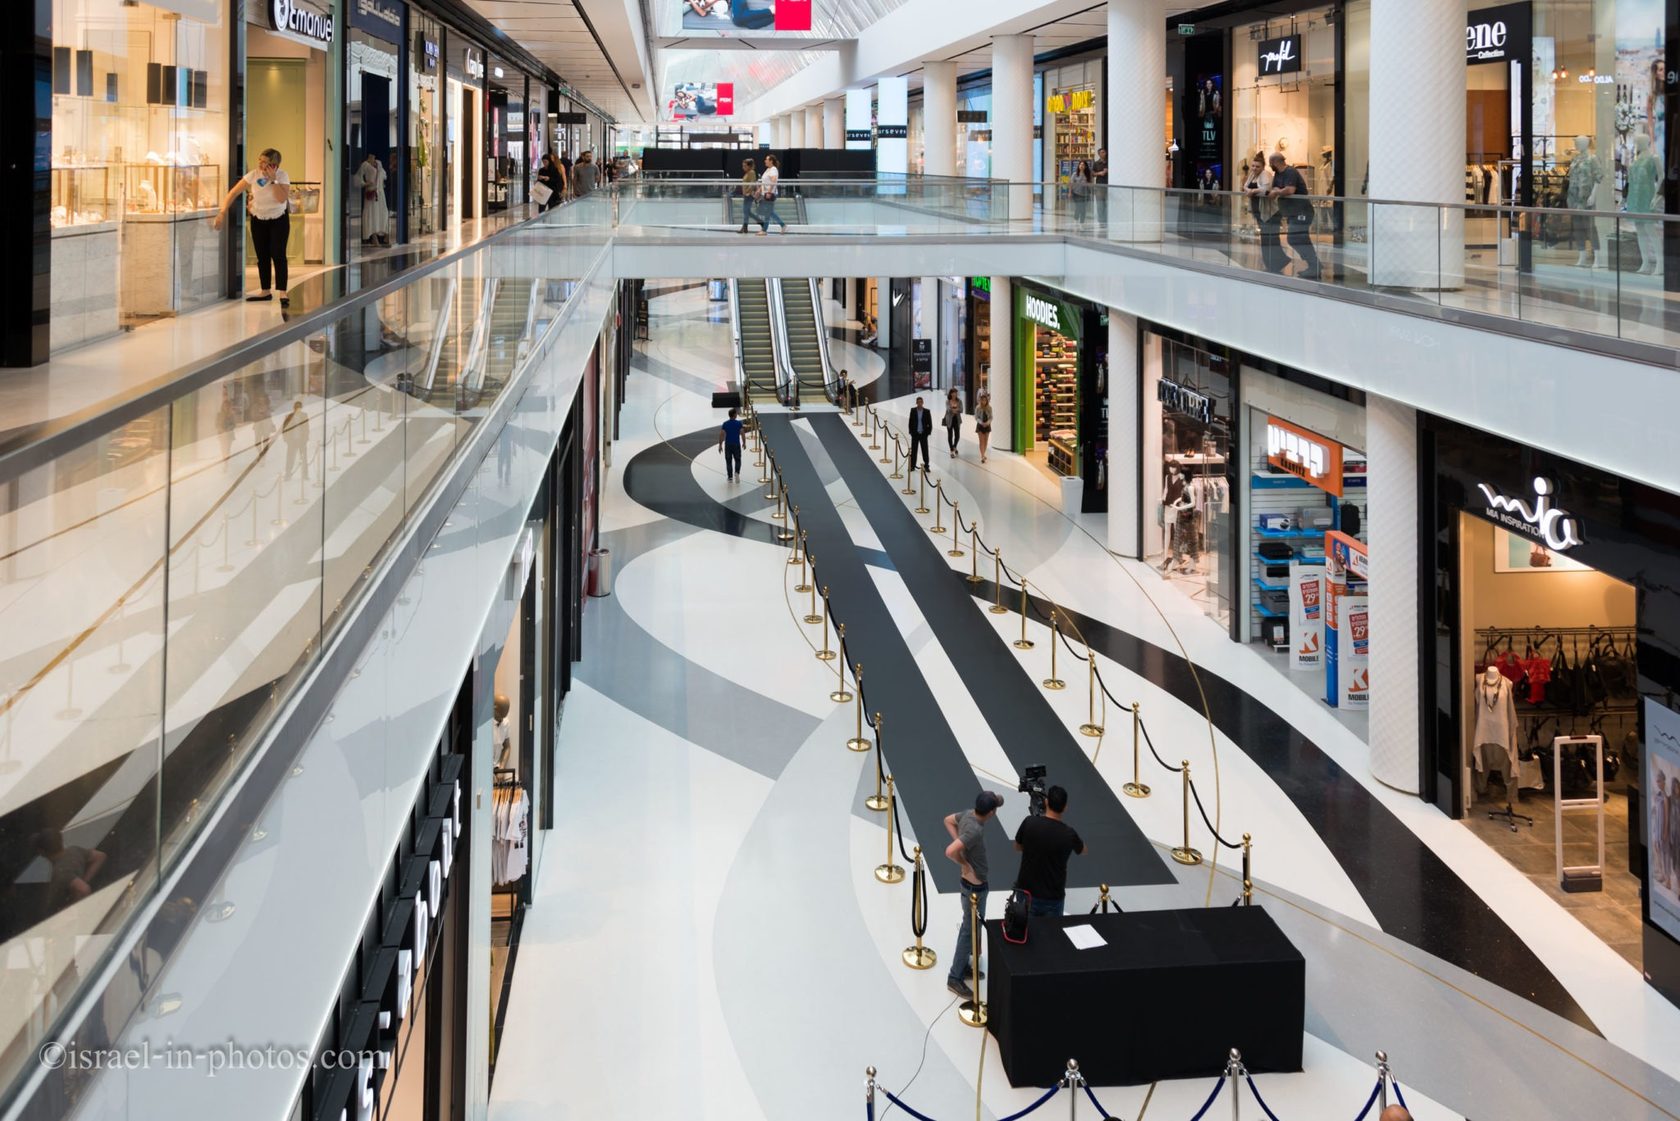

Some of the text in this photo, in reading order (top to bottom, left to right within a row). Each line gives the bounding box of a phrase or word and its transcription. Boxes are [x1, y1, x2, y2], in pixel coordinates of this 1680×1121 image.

[288, 0, 335, 42] Emanuel
[1467, 21, 1506, 50] ene
[1202, 130, 1216, 141] TLV
[1478, 476, 1581, 550] mia
[1486, 507, 1499, 520] MIA
